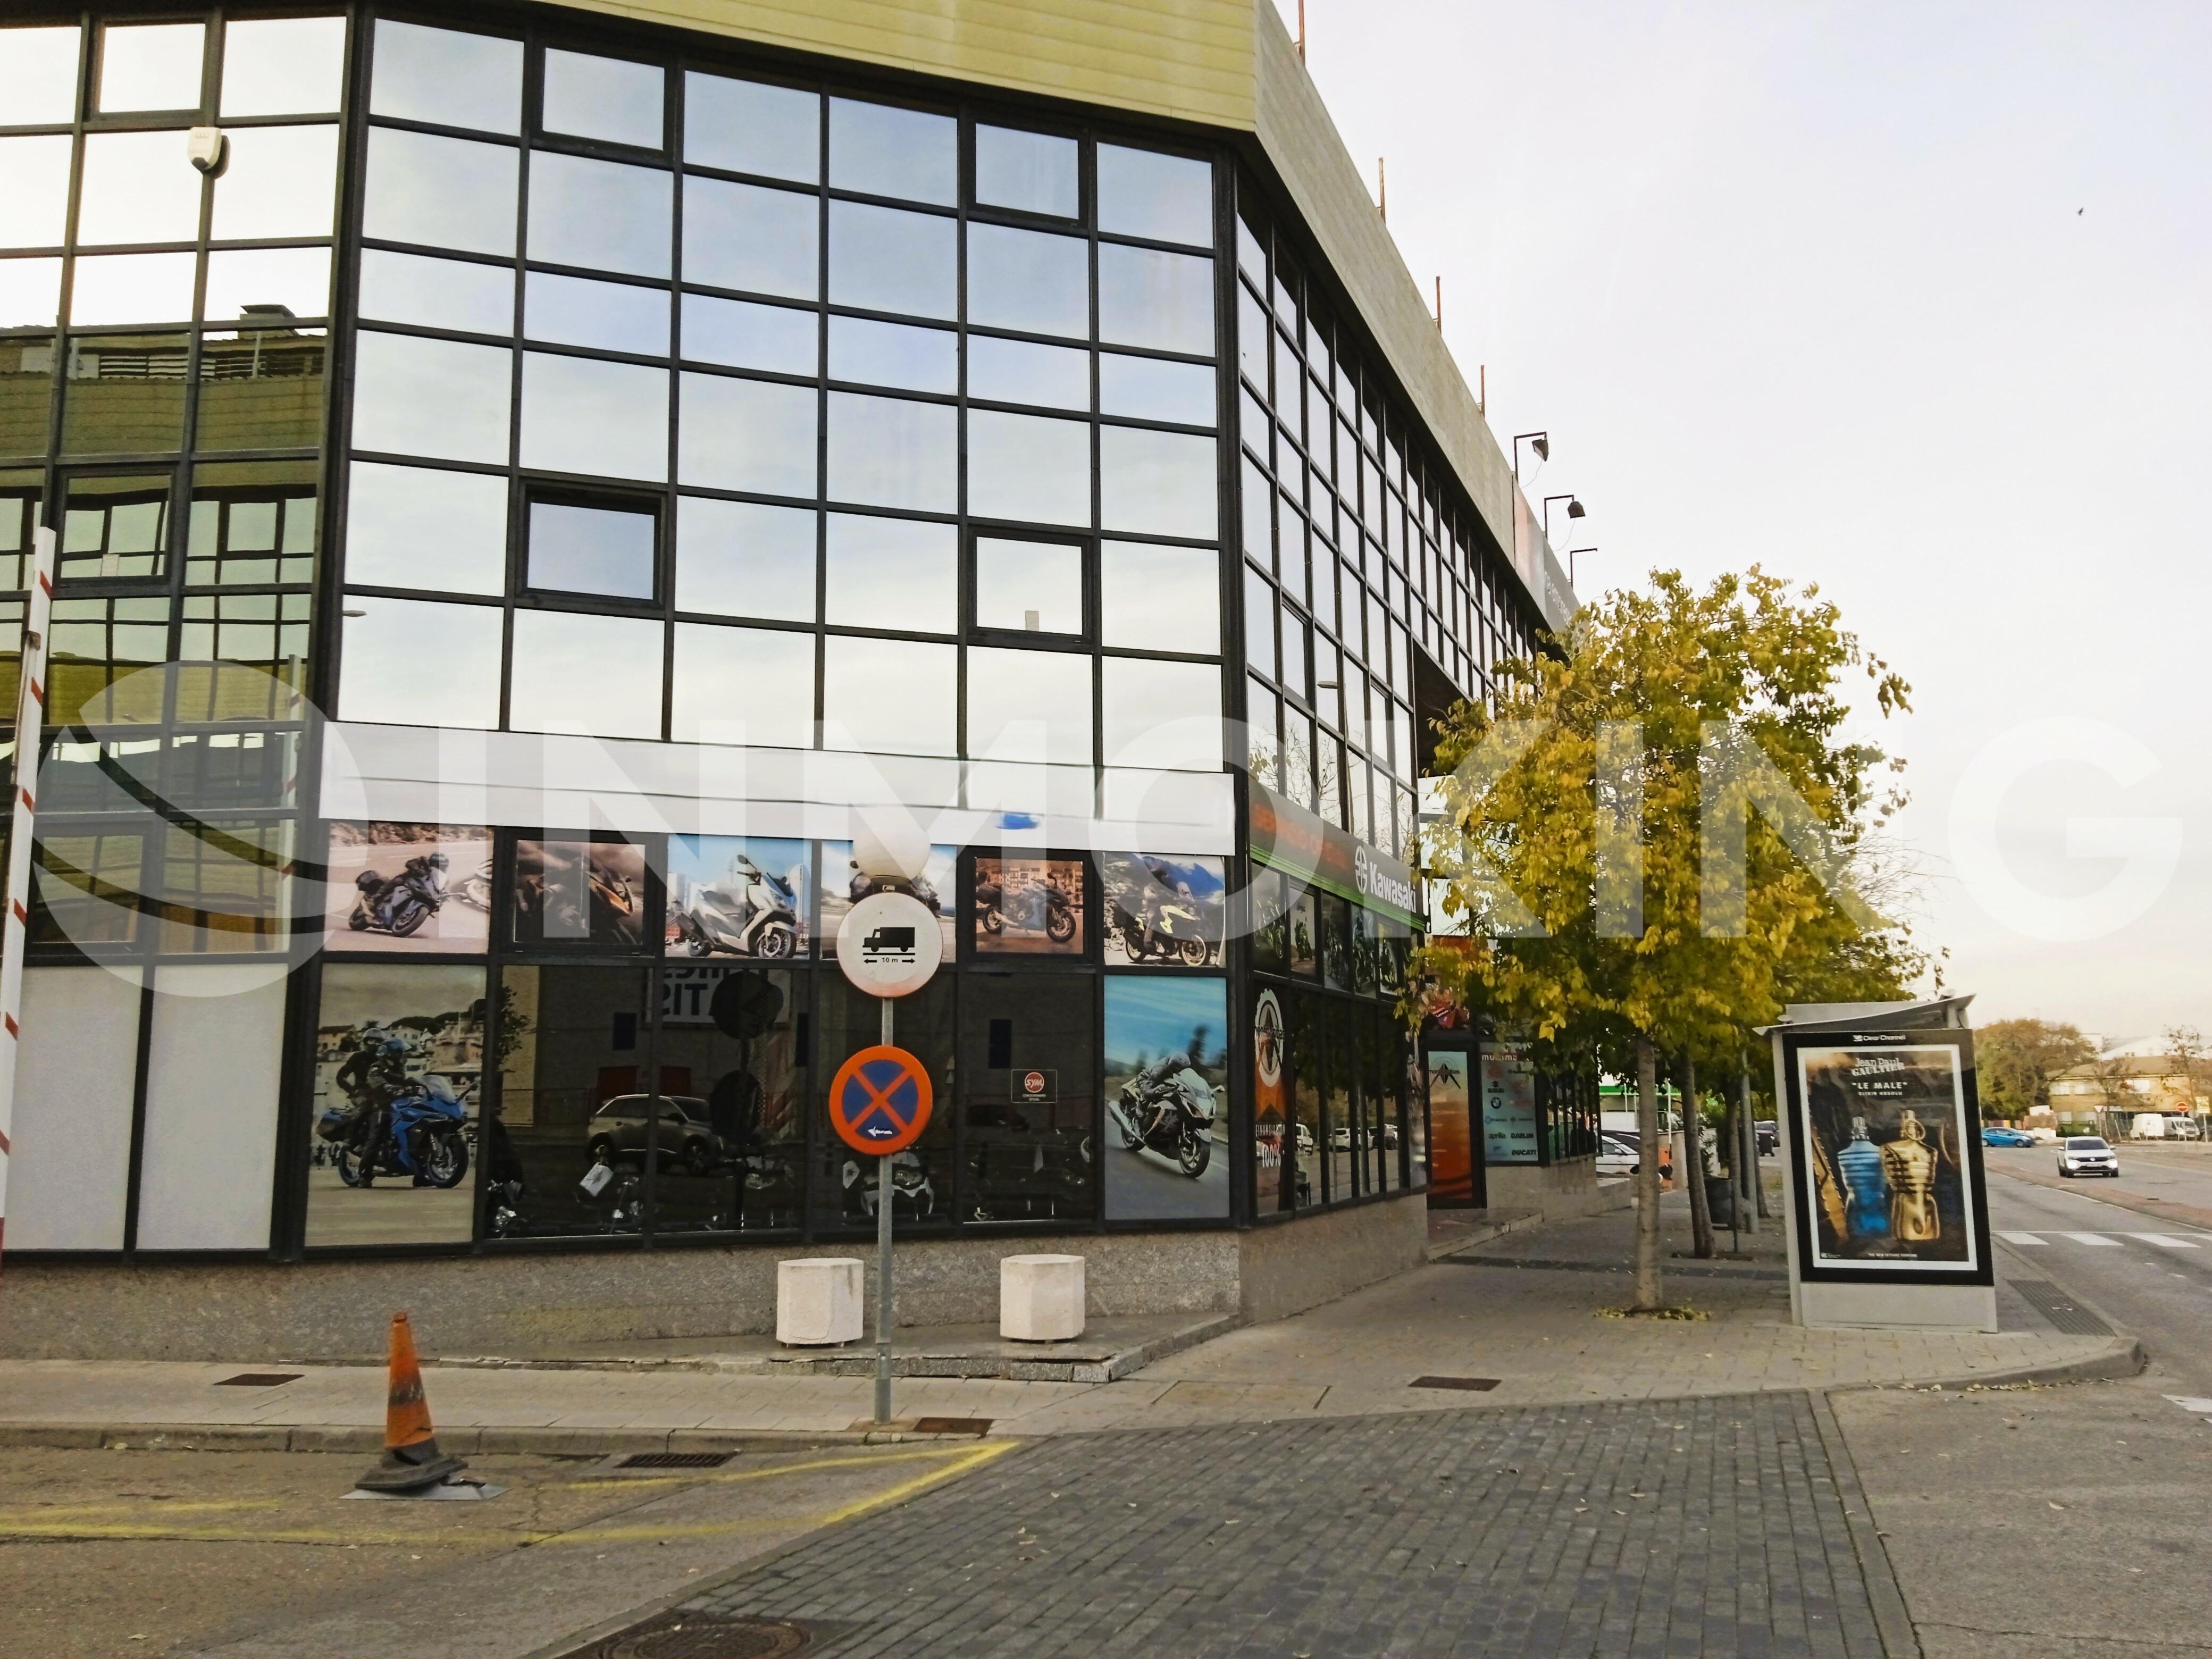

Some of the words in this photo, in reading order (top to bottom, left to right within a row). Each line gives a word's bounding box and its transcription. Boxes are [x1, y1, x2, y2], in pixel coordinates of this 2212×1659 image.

[1370, 862, 1417, 914] Kawasaki
[1851, 1062, 1905, 1076] GAULTIER
[1855, 1058, 1876, 1067] Jean
[1877, 1057, 1899, 1066] Paul
[1026, 1079, 1043, 1088] SYM
[1262, 1144, 1281, 1168] 100%
